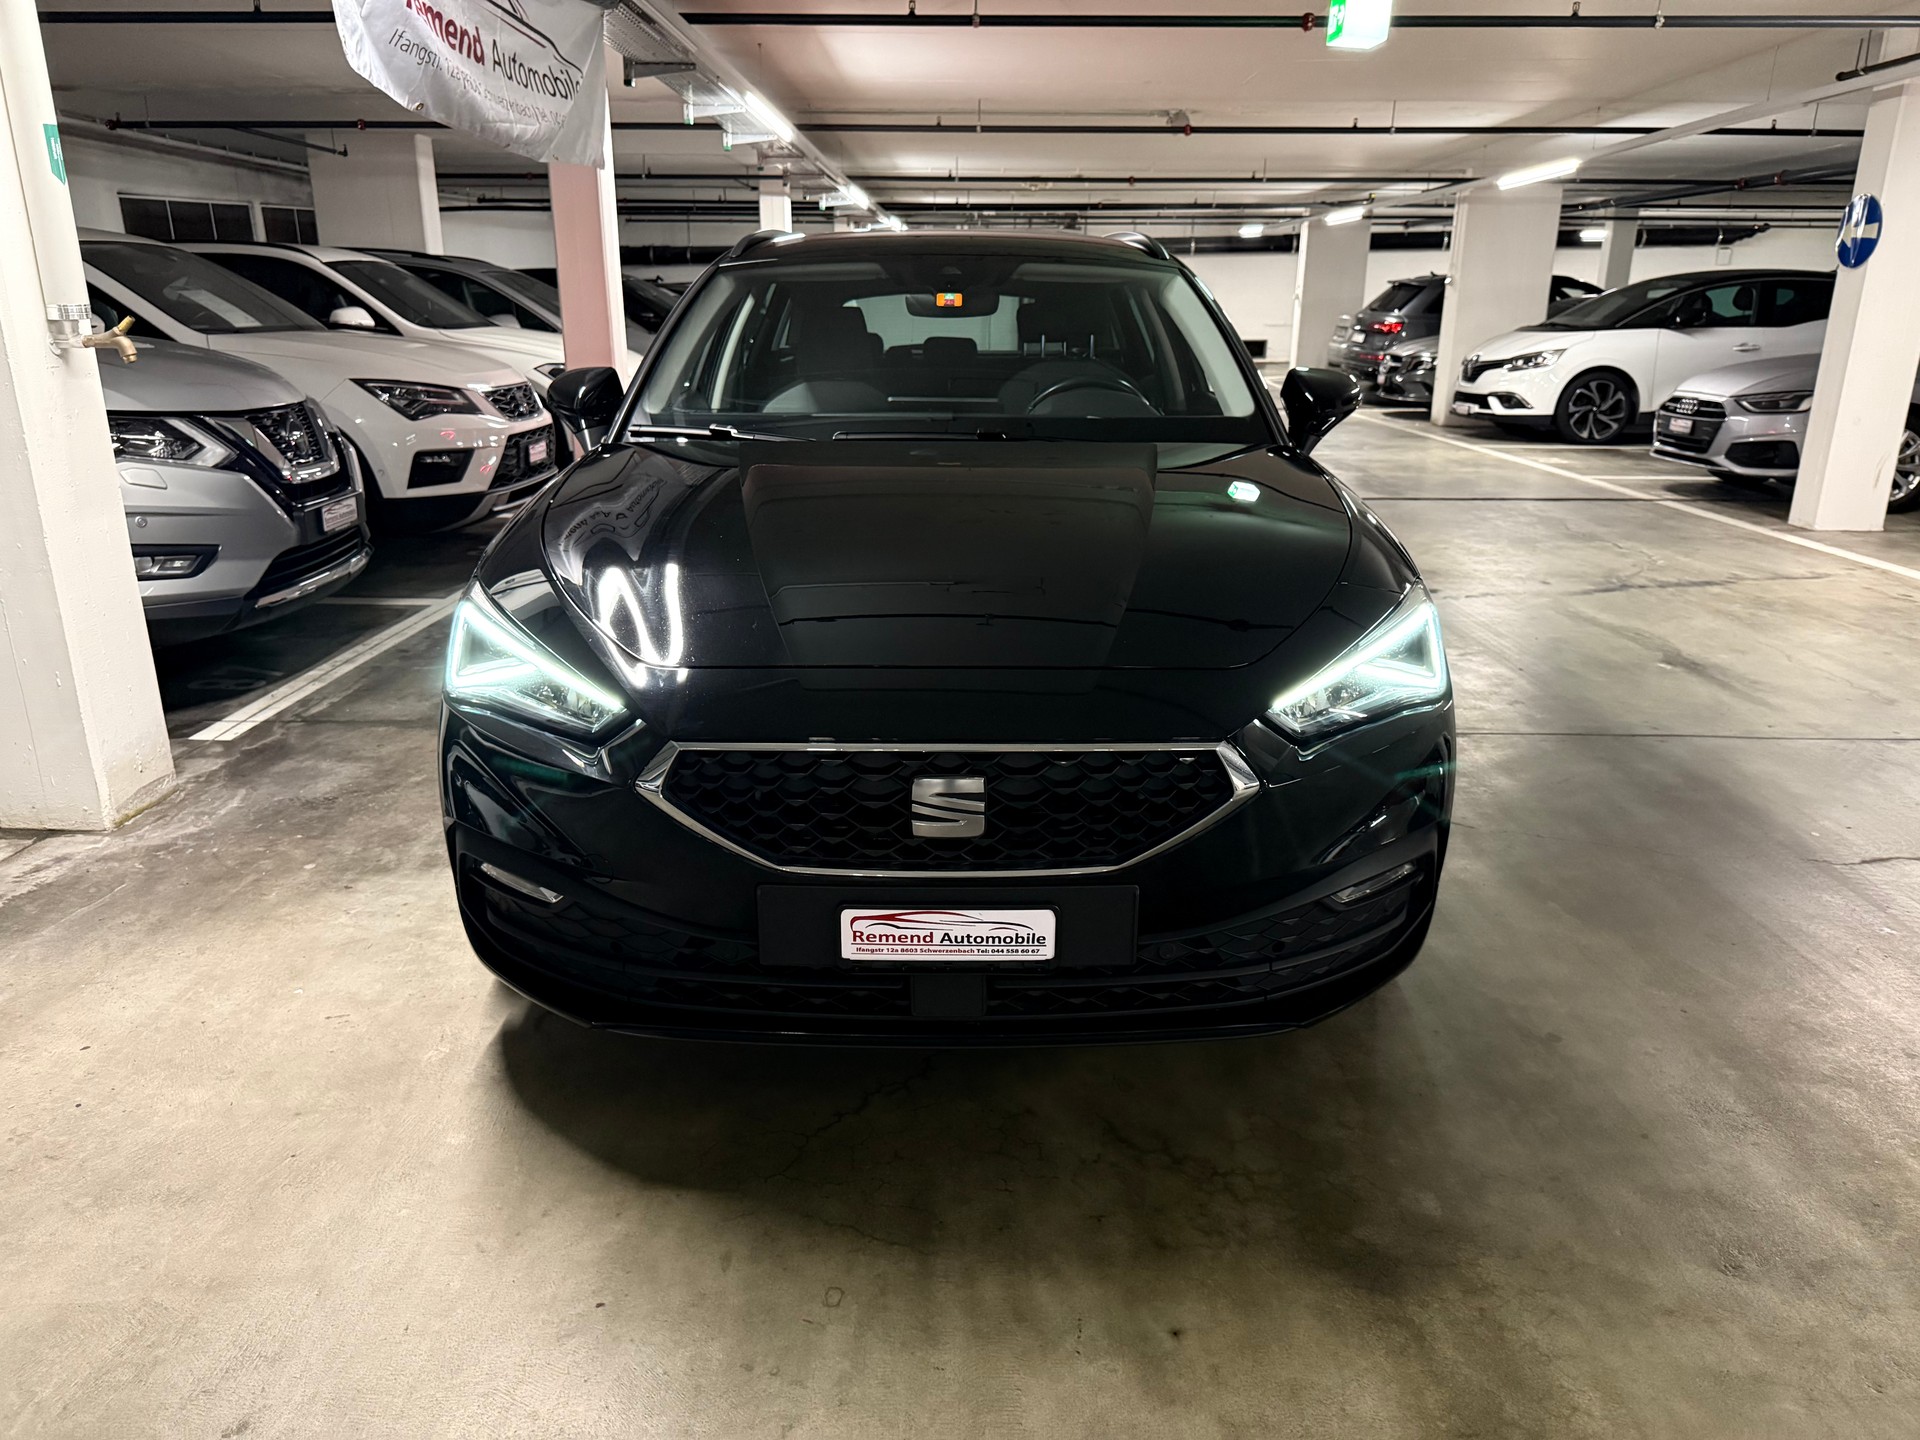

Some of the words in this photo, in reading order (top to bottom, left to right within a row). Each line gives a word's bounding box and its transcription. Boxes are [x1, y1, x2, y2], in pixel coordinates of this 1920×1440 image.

[406, 0, 486, 66] emend
[852, 930, 934, 944] Remend
[939, 932, 1047, 945] Automobile
